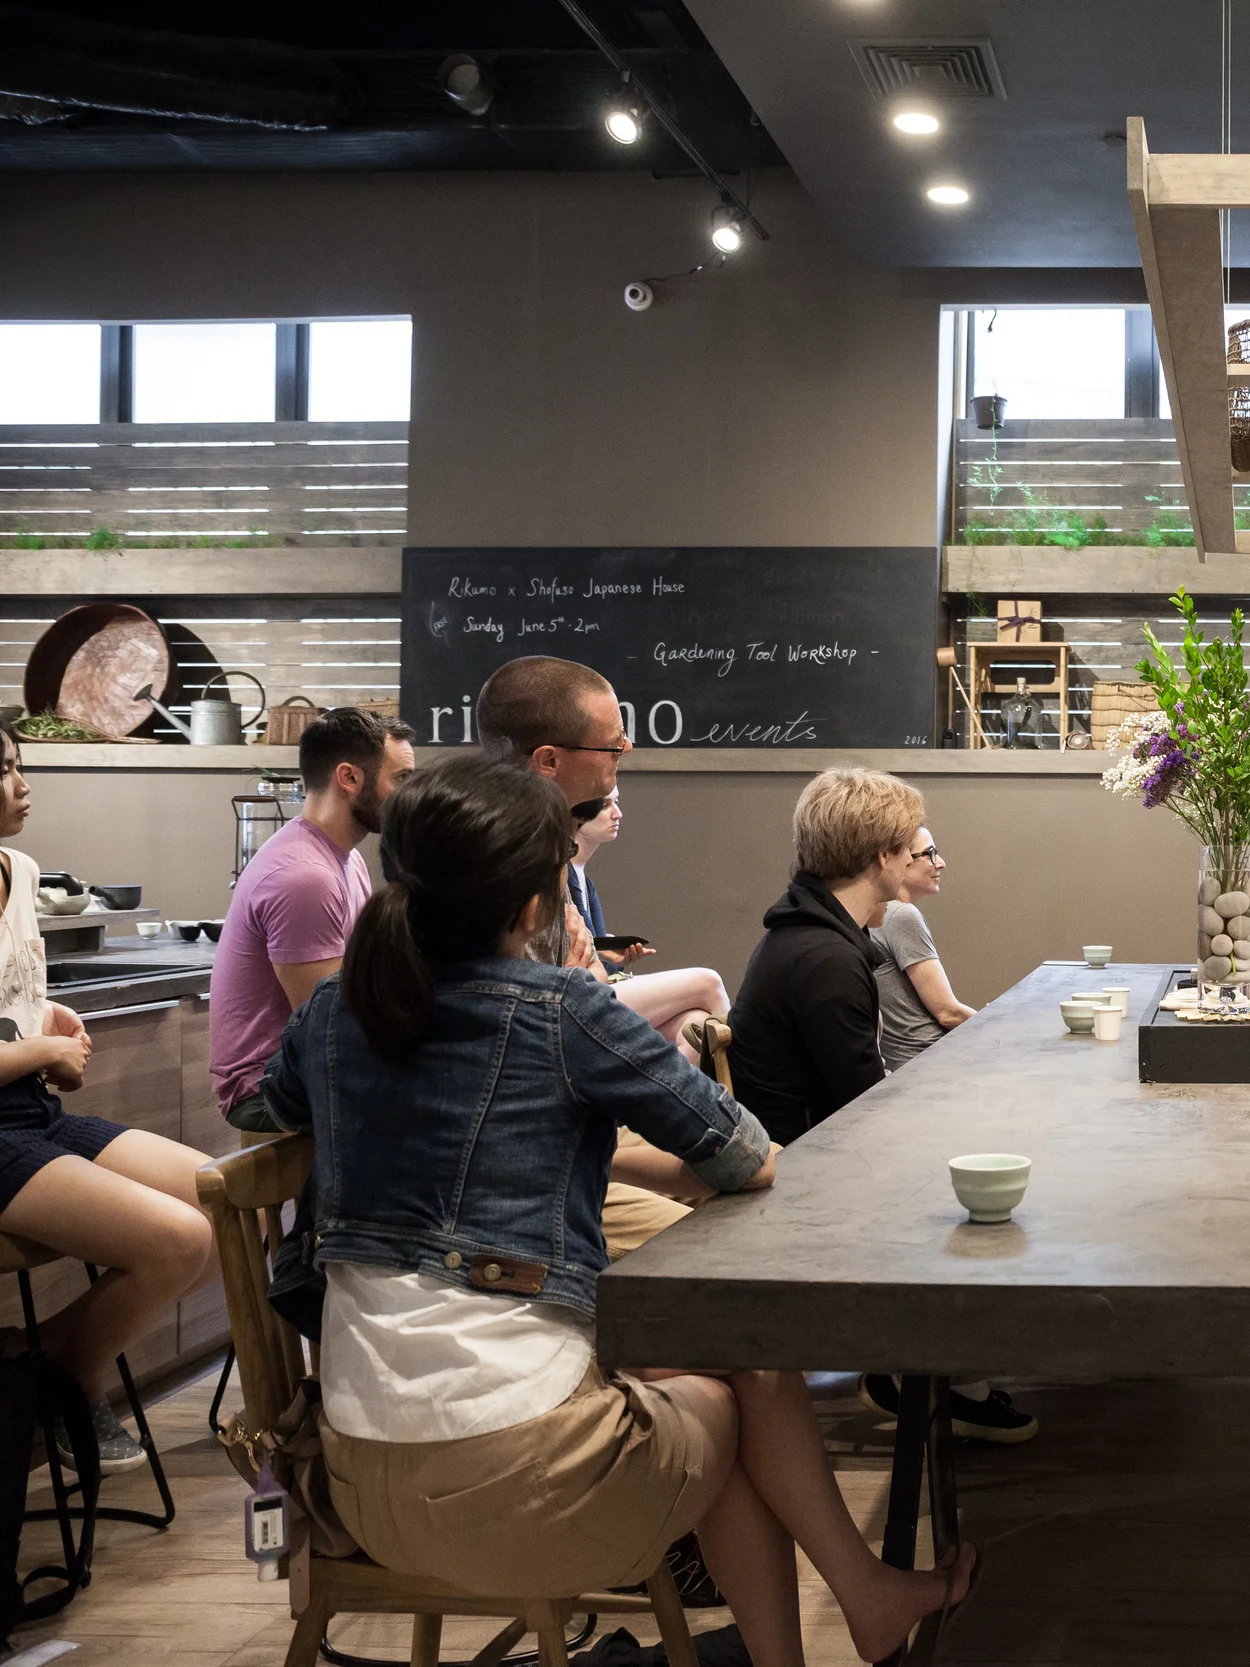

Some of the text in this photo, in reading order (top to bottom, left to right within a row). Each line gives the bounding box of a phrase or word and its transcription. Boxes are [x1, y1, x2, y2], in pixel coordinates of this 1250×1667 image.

[448, 577, 497, 598] Rikumo
[526, 577, 574, 603] Shofuso
[583, 577, 643, 600] Japanese
[653, 575, 686, 596] House
[463, 616, 505, 643] Sunday
[517, 618, 546, 636] June
[653, 642, 738, 677] Gardening
[746, 641, 778, 662] Tool
[788, 641, 858, 666] Workshop
[690, 710, 829, 744] events
[904, 735, 928, 746] 2016
